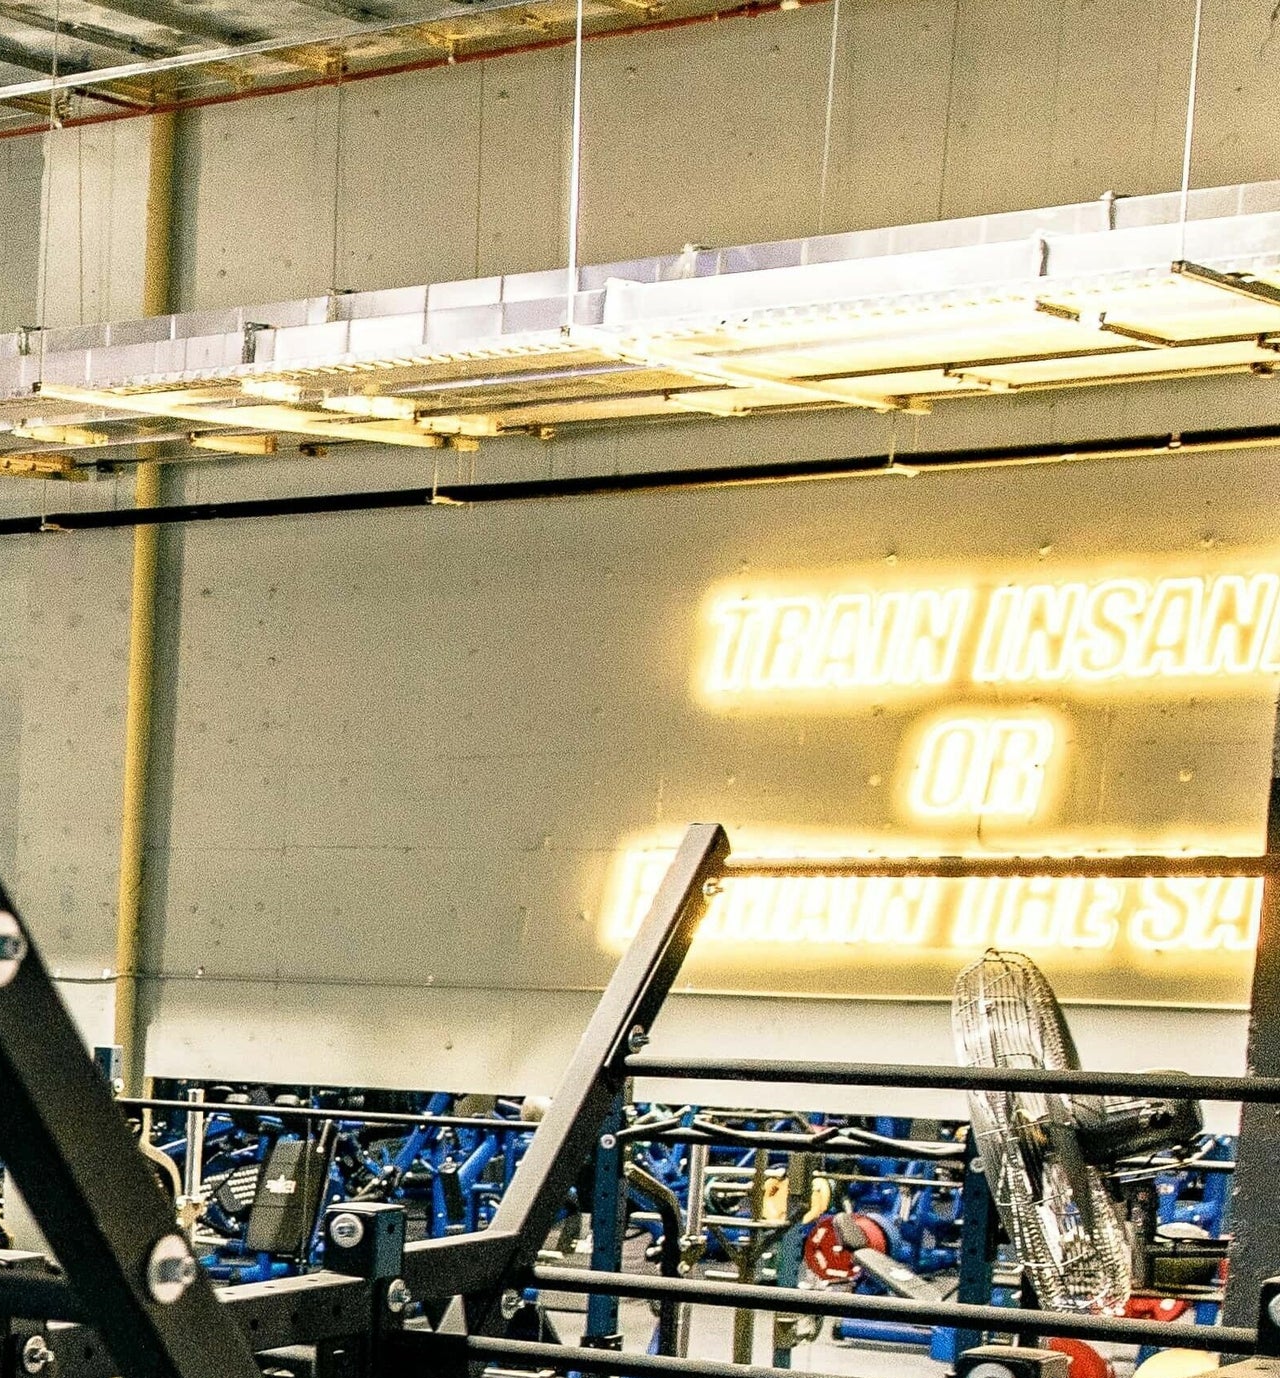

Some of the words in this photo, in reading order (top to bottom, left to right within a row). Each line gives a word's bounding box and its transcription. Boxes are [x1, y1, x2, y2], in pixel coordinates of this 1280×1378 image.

[708, 589, 968, 692] TRAIN
[910, 713, 1055, 817] OR
[611, 846, 948, 944] RMAIN
[1126, 850, 1265, 950] SA
